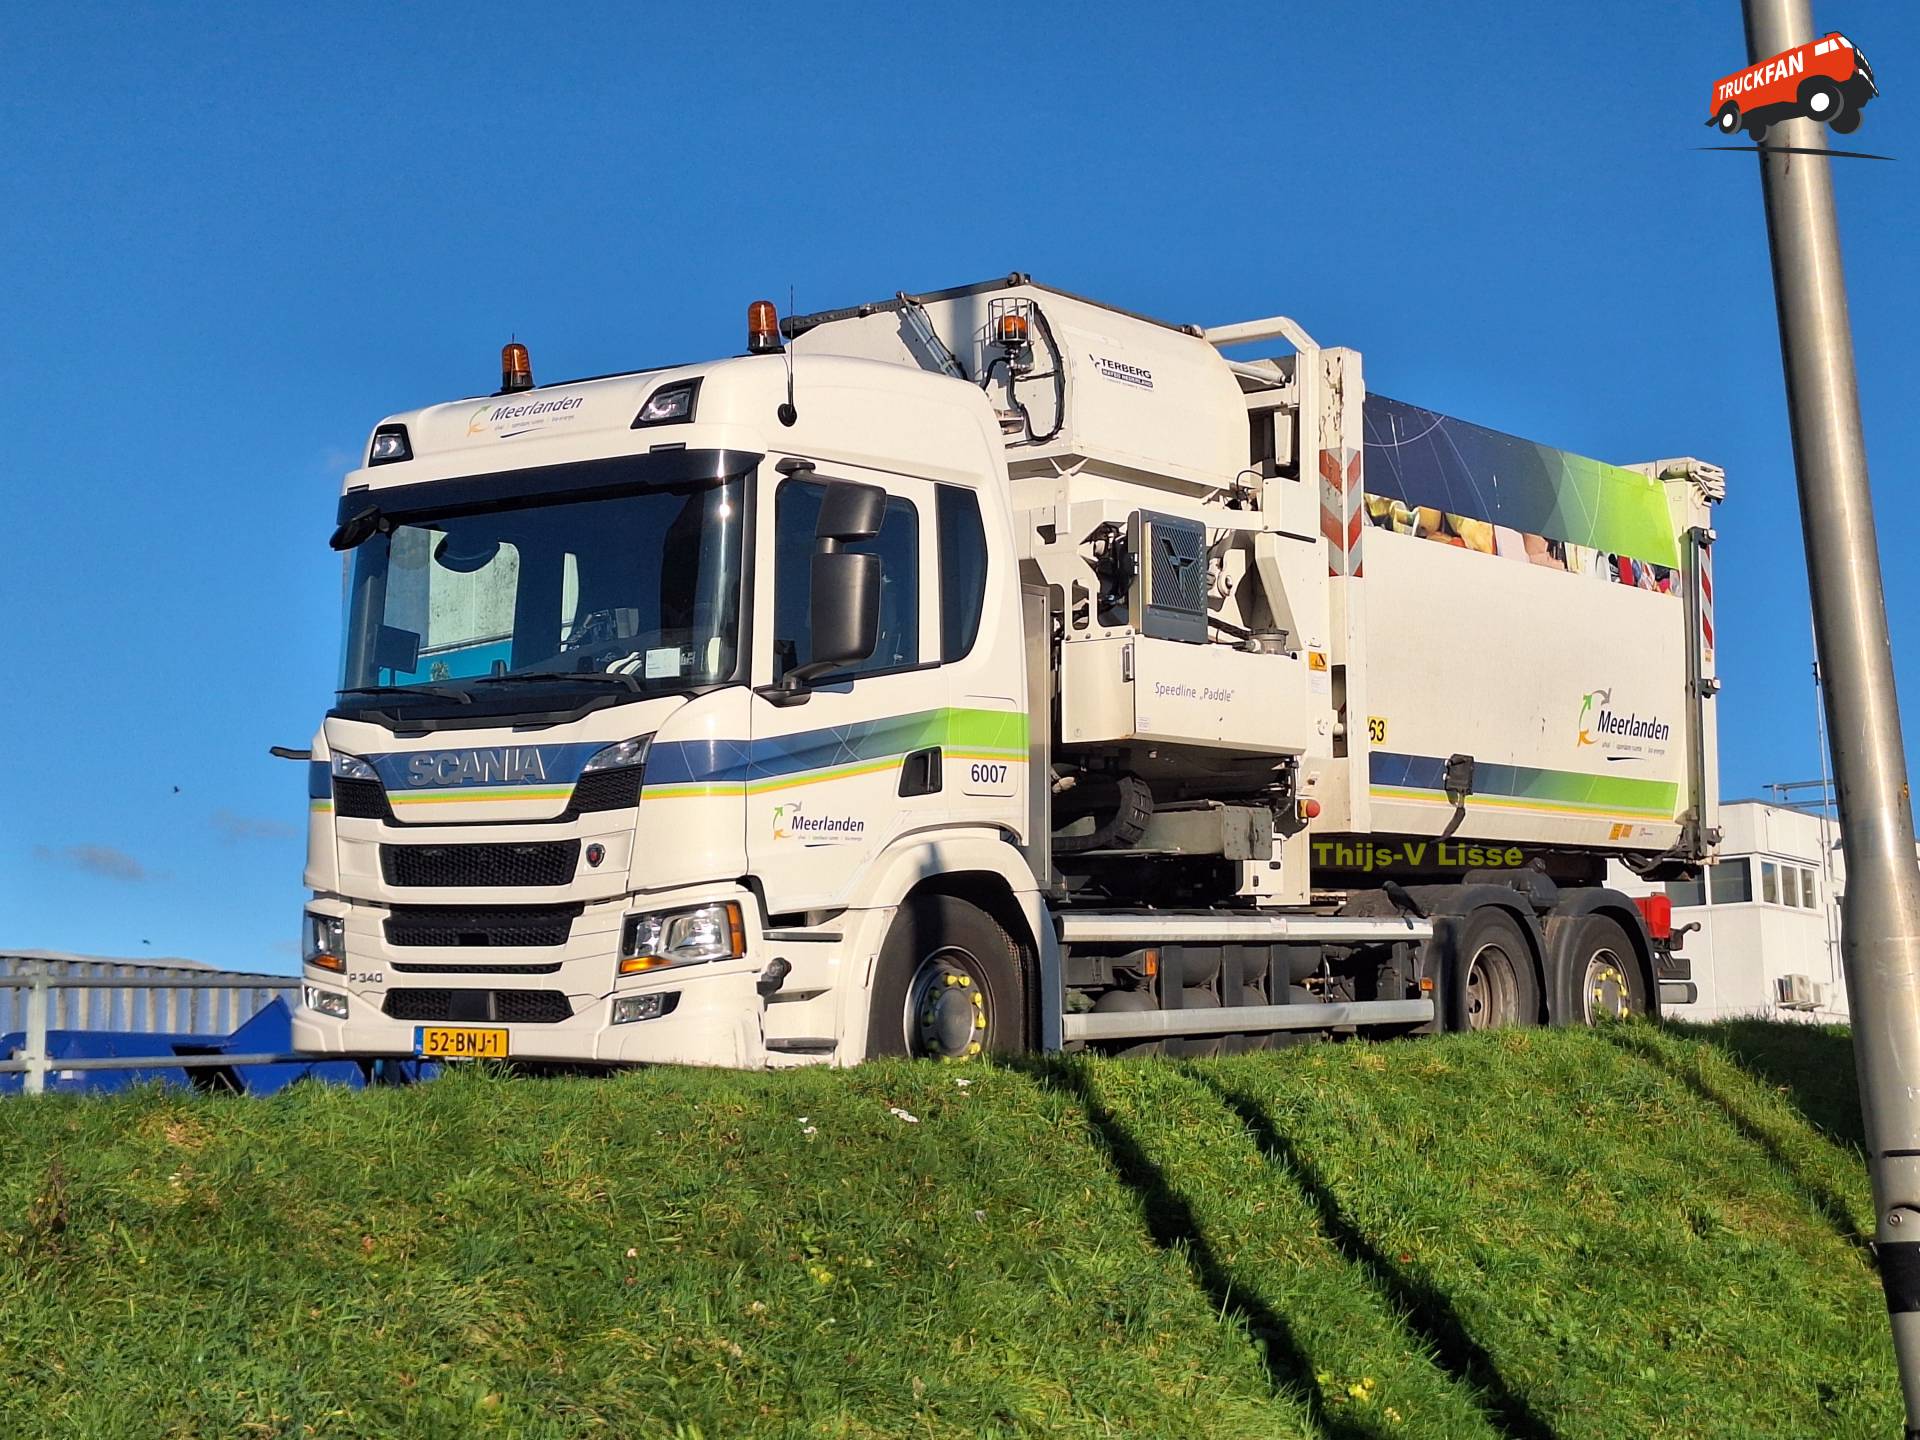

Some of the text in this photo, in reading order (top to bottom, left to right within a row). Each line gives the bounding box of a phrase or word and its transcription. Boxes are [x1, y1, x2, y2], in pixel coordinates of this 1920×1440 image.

[1100, 358, 1152, 379] TERBERG
[490, 396, 583, 421] Meerlanden
[1155, 682, 1197, 698] Speedline
[1598, 710, 1669, 741] Meerlanden
[408, 748, 546, 787] SCANIA
[971, 764, 1007, 783] 6007
[792, 815, 864, 832] Meerlanden
[429, 1032, 498, 1053] 52-BNJ-1
